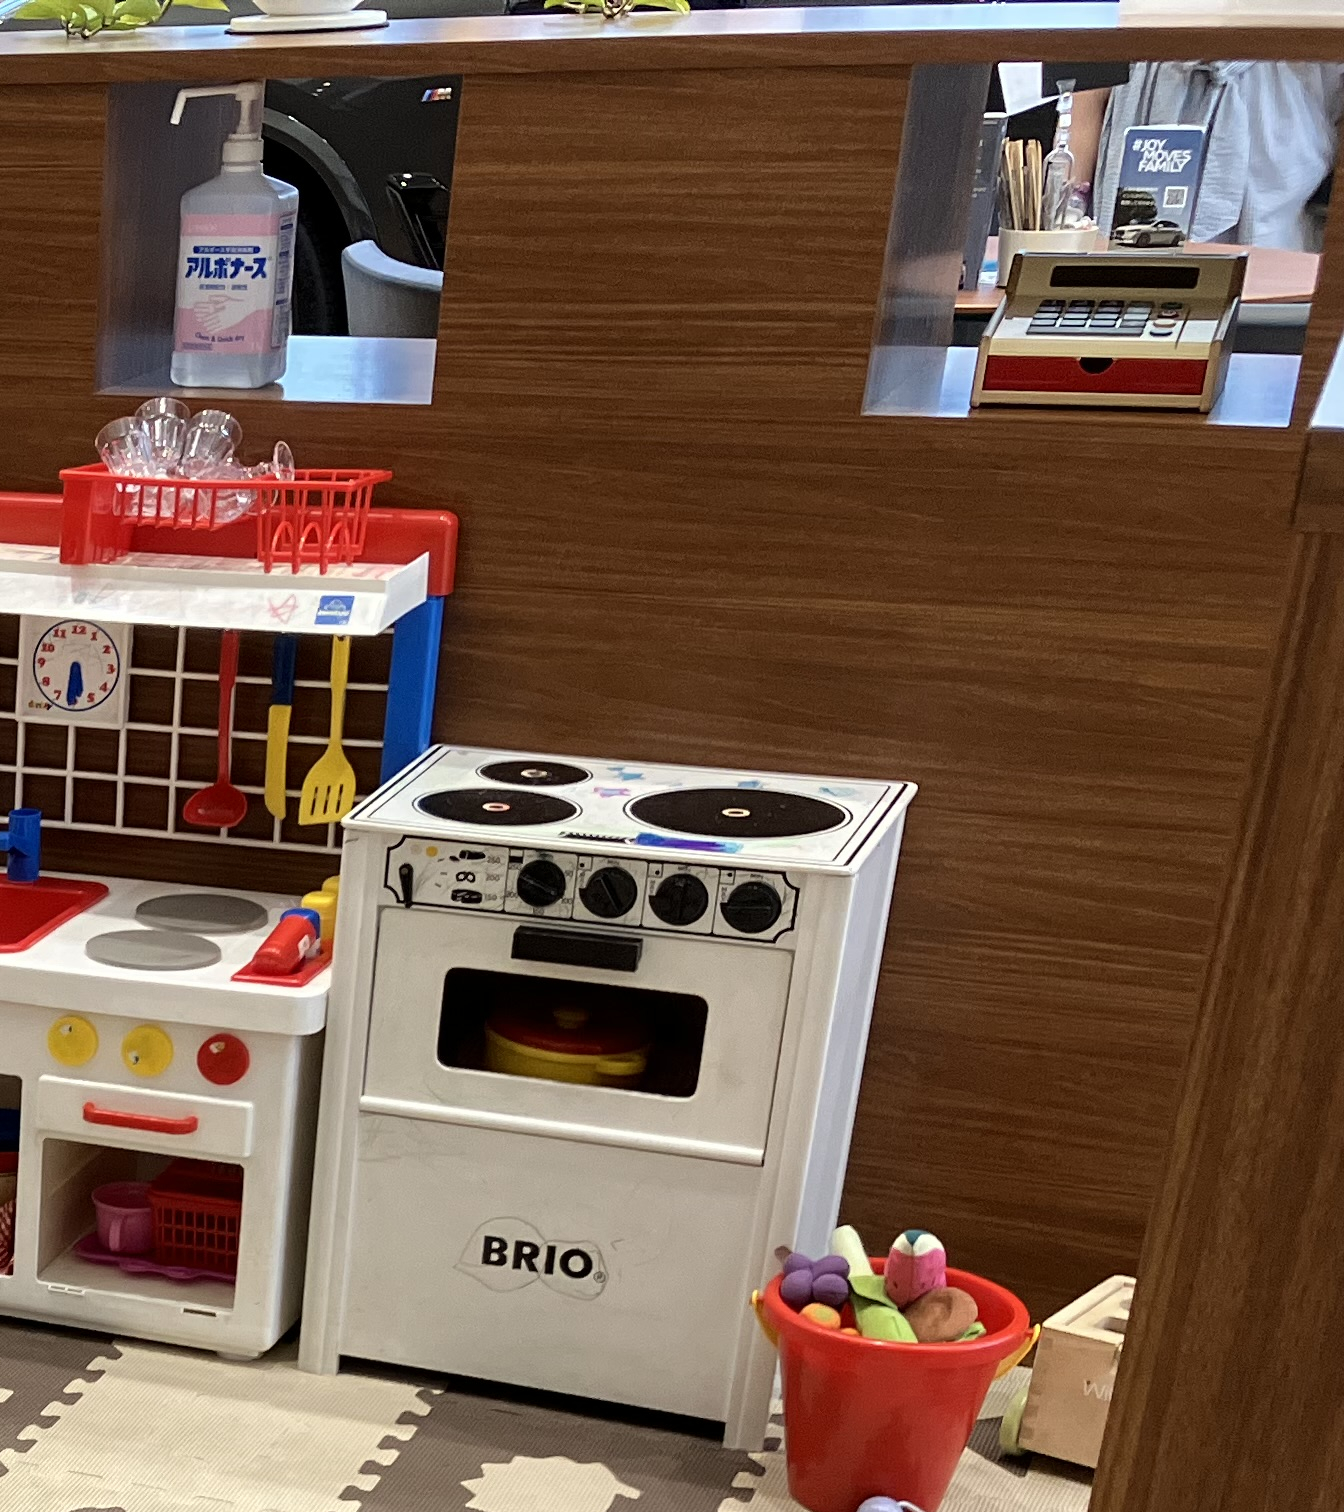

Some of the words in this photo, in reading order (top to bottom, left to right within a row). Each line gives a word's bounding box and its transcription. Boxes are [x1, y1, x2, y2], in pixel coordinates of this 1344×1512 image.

[1132, 138, 1168, 152] #JOY
[1142, 150, 1192, 162] MOVES
[1137, 160, 1189, 173] FAMILY
[185, 257, 268, 280] アルボナース
[53, 628, 67, 639] 11
[72, 625, 87, 635] 12
[90, 631, 98, 641] 1
[41, 642, 55, 653] 10
[102, 645, 111, 654] 2
[37, 657, 46, 668] 9
[106, 663, 116, 674] 3
[41, 676, 50, 687] 8
[99, 681, 109, 693] 4
[53, 689, 62, 701] 7
[86, 692, 96, 703] 5
[481, 1235, 593, 1279] BRIO
